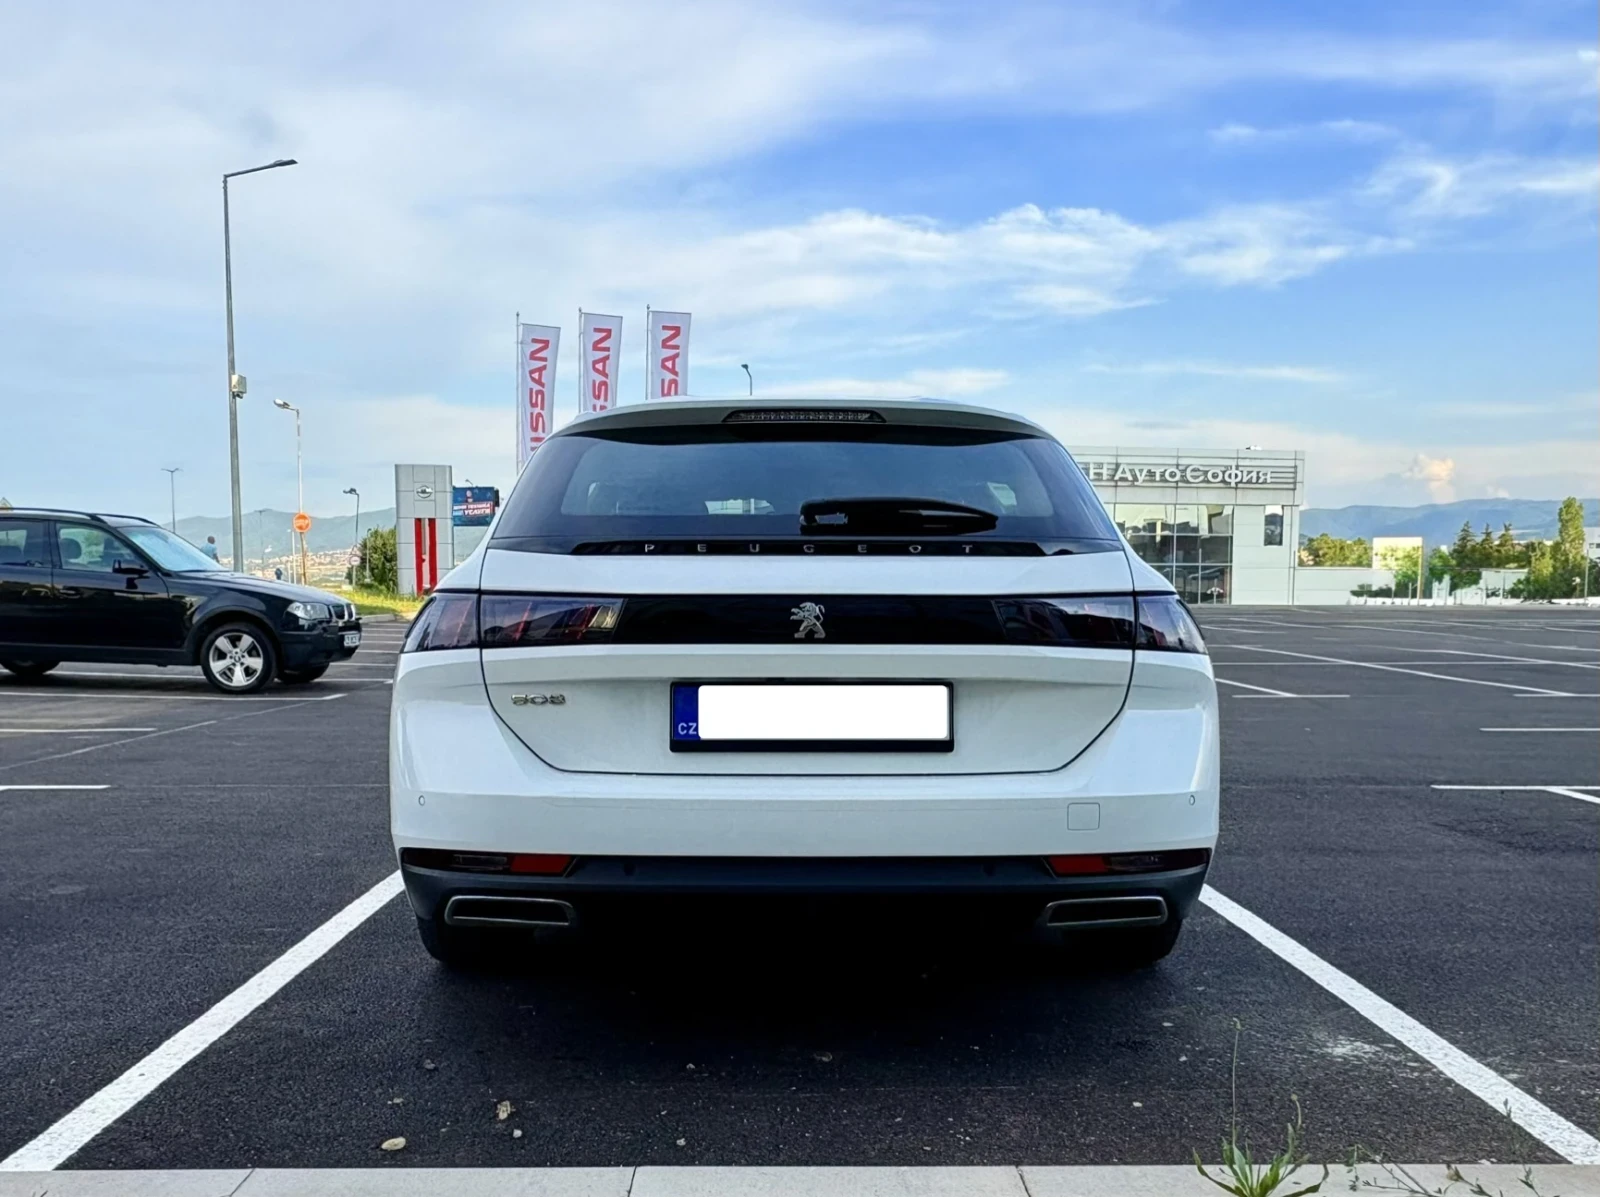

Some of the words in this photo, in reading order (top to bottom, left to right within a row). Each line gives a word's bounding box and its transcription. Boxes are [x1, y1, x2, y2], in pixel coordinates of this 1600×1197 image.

[529, 338, 550, 452] ISSAN
[1186, 464, 1272, 487] София
[644, 543, 973, 554] PEUGEOT
[511, 693, 566, 706] 508
[677, 722, 697, 736] CZ
